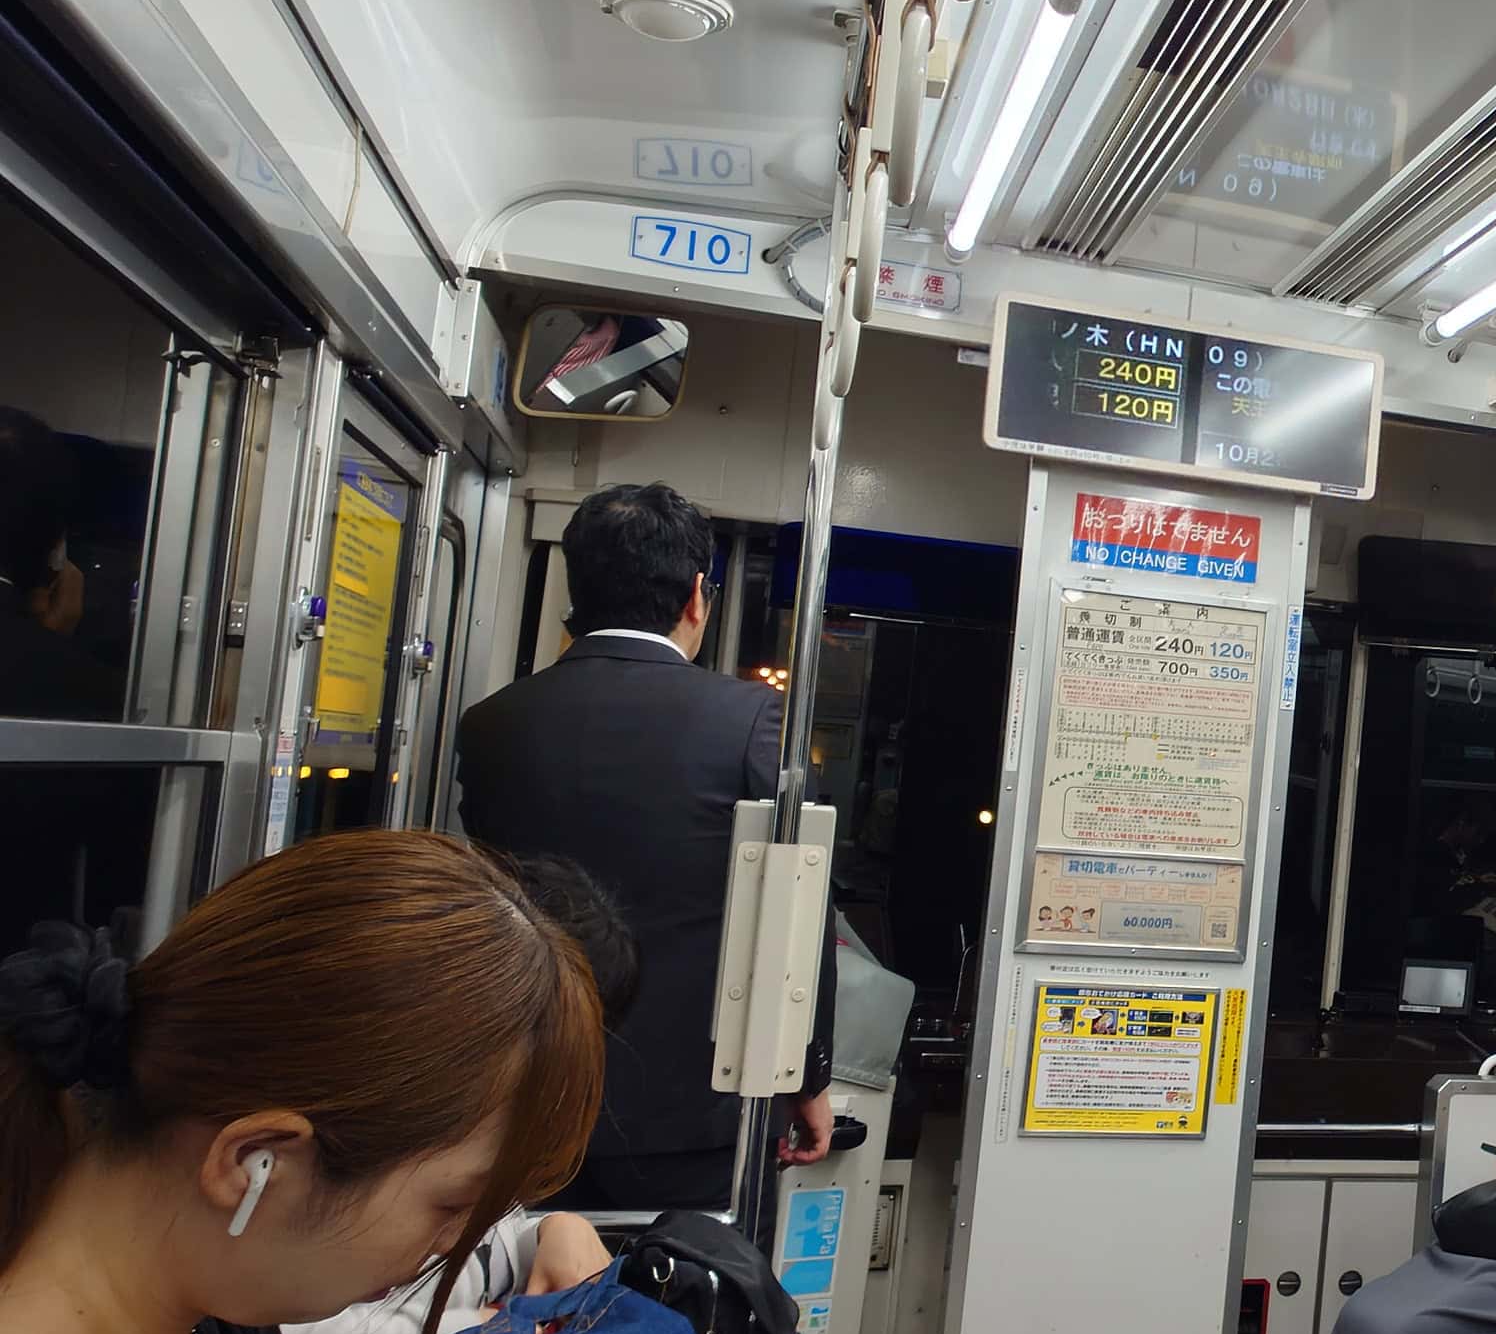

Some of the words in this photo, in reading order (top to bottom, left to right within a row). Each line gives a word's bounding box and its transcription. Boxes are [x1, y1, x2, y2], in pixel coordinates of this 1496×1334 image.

[655, 224, 731, 266] 710
[1099, 358, 1177, 391] 240円
[1098, 393, 1174, 424] 120円
[1081, 502, 1251, 548] おつりはでません
[1085, 545, 1110, 563] NO
[1121, 550, 1187, 572] CHANGE
[1198, 558, 1245, 579] GIVEN
[1067, 626, 1125, 645] 普通運賃
[1155, 636, 1204, 657] 240円
[1210, 641, 1254, 661] 120円
[1158, 661, 1198, 677] 700円
[1209, 665, 1249, 681] 350円
[1282, 613, 1301, 702] 運転室立入禁止
